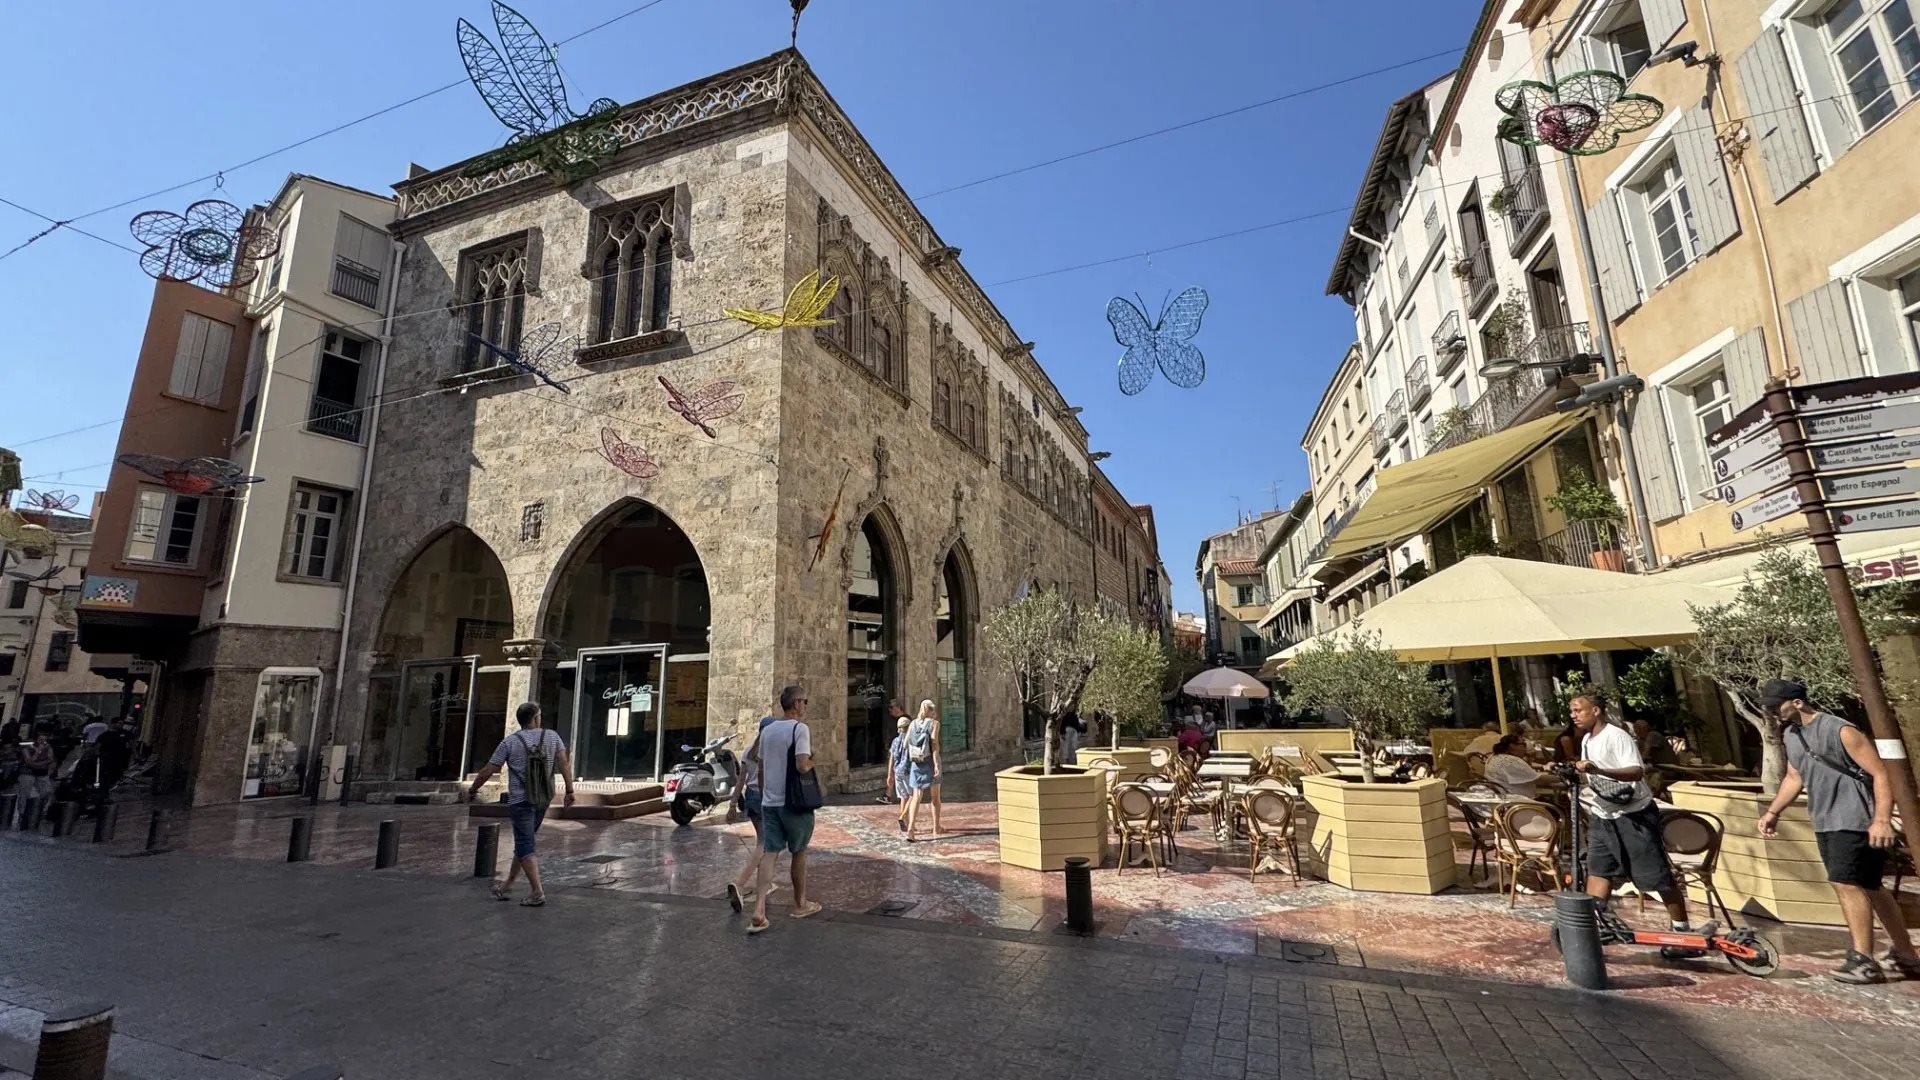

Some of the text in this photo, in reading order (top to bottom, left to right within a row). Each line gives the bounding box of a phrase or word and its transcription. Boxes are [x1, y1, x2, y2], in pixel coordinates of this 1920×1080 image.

[1839, 413, 1872, 425] Maillol
[1828, 446, 1862, 457] Castillet
[1870, 442, 1899, 452] Musée
[1829, 477, 1900, 492] Centro Espagnol
[1856, 513, 1868, 521] Le
[1870, 510, 1895, 521] Petit
